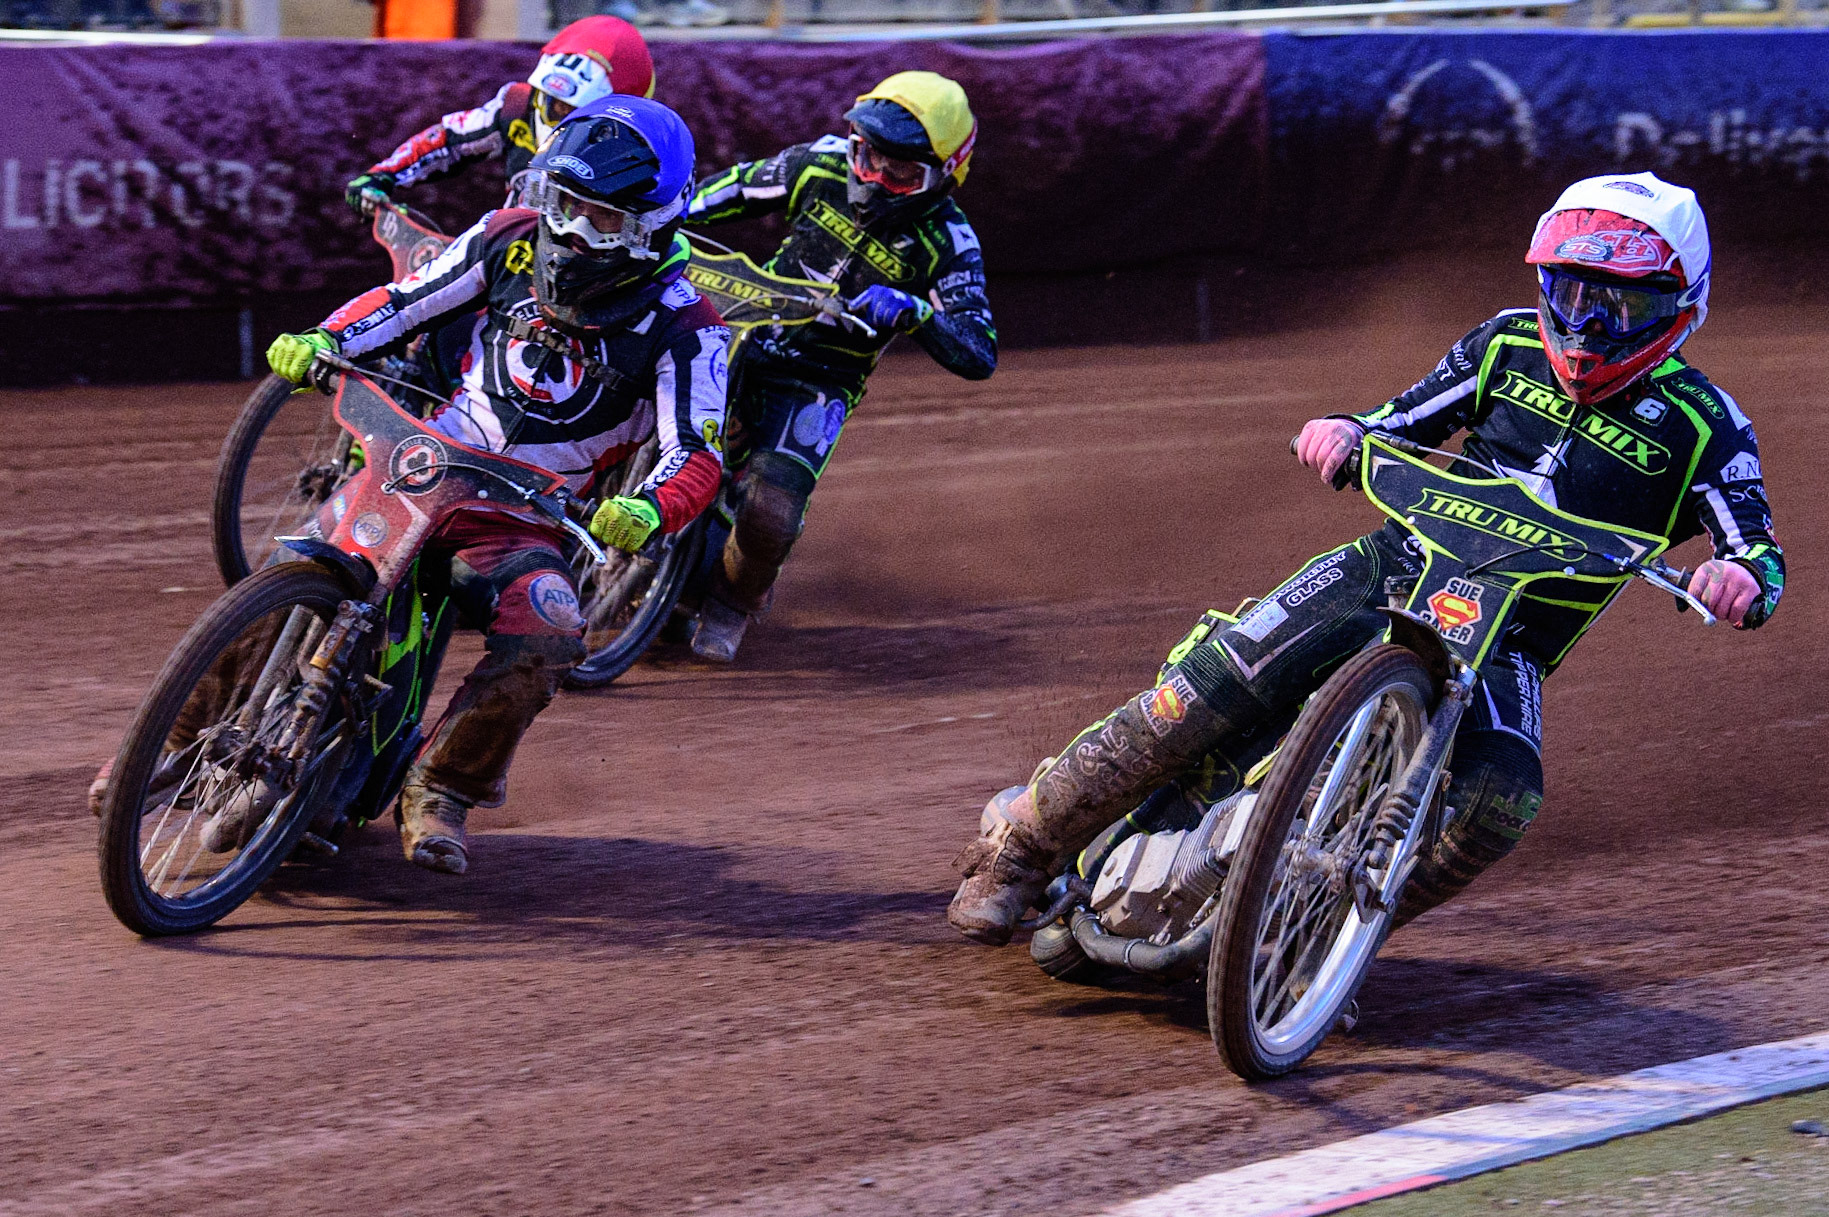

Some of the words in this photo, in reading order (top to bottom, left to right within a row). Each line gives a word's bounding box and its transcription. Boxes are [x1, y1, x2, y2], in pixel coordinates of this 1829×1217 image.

[552, 156, 590, 177] SHOEI
[819, 208, 864, 245] TRU
[865, 242, 902, 280] MIX
[1563, 242, 1603, 255] STS
[688, 267, 728, 290] TRU
[728, 281, 773, 308] MIX
[516, 304, 541, 321] ELL
[1508, 378, 1577, 421] TRU
[1580, 413, 1661, 468] MIX
[1633, 398, 1666, 421] 6
[1427, 494, 1499, 527] TRU
[1496, 516, 1576, 556] MIX
[1287, 568, 1344, 608] GLASS
[1447, 579, 1481, 602] SUE
[1421, 612, 1472, 642] BAER
[1171, 677, 1196, 705] SUE
[1508, 651, 1532, 698] TIPPER
[1520, 696, 1534, 737] HIRE
[1047, 757, 1080, 800] N
[1076, 742, 1107, 777] &
